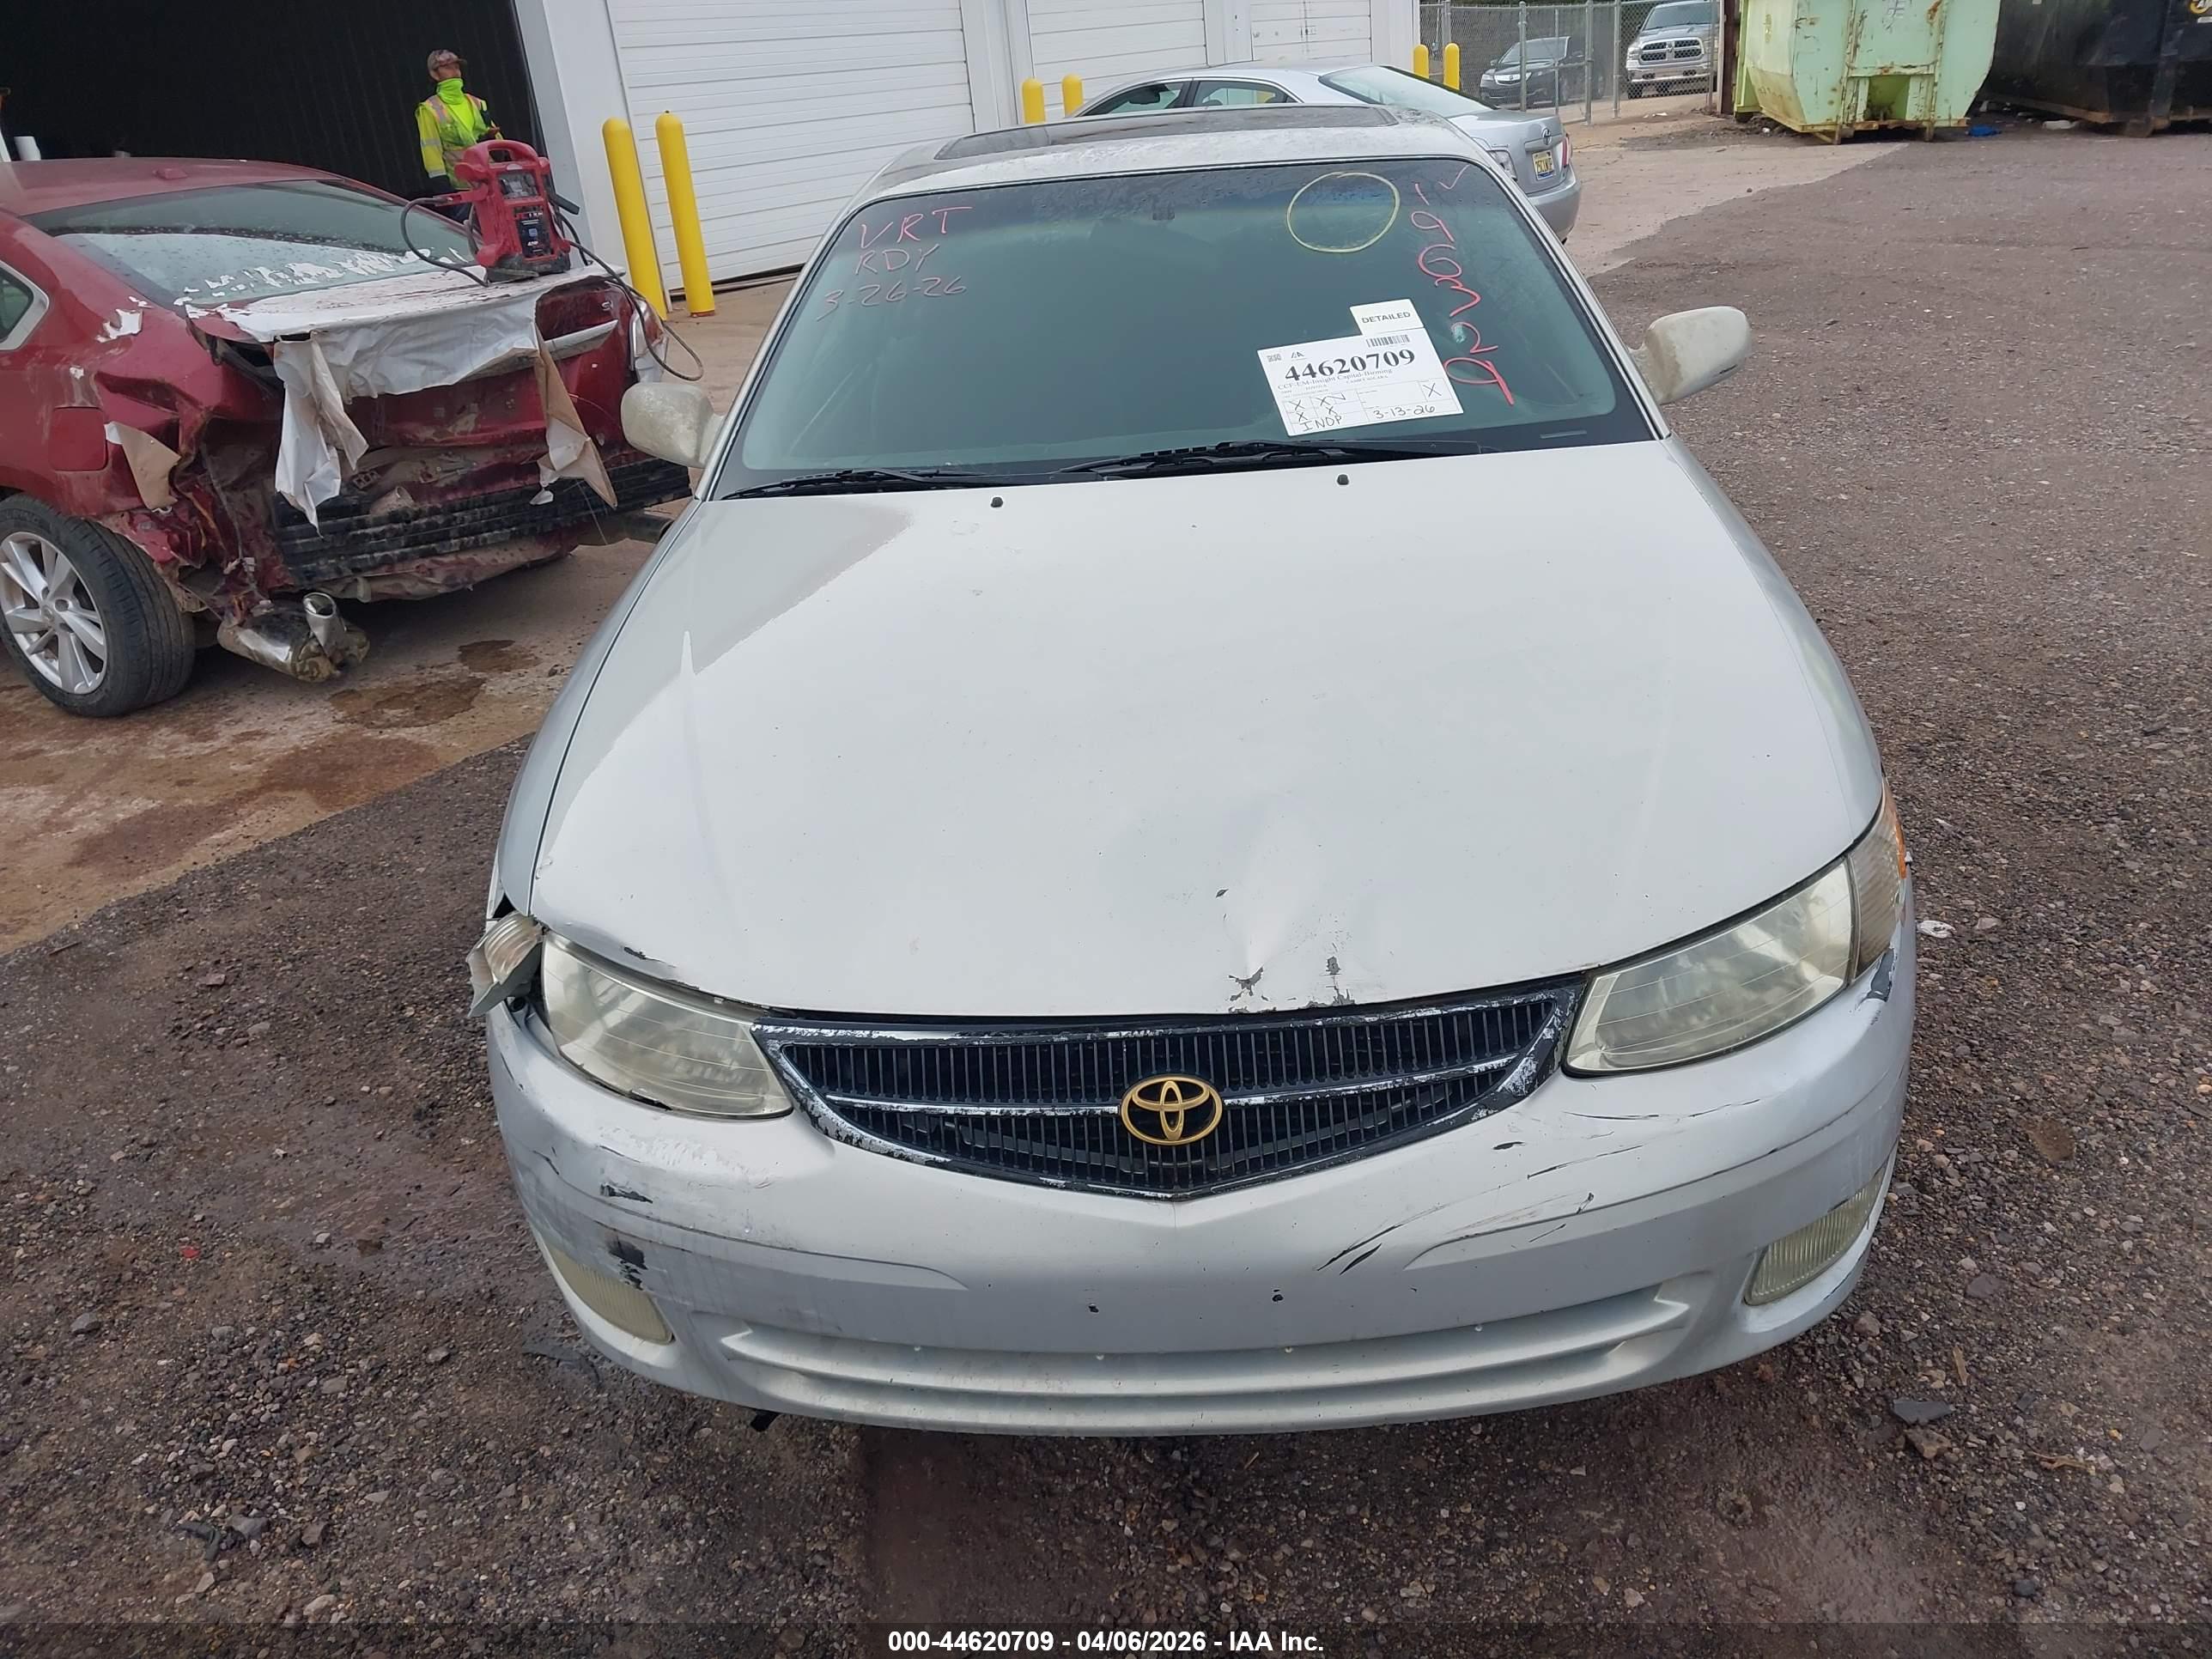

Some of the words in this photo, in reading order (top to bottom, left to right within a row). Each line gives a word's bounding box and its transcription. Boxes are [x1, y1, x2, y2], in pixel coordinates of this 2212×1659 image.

[861, 206, 973, 249] VRT
[855, 243, 939, 275] RDY
[817, 276, 967, 322] 3-26-26
[1361, 311, 1411, 325] DETAILED
[1285, 349, 1416, 381] 44620709
[1300, 415, 1342, 432] INOP
[1373, 404, 1436, 420] 3-13-26
